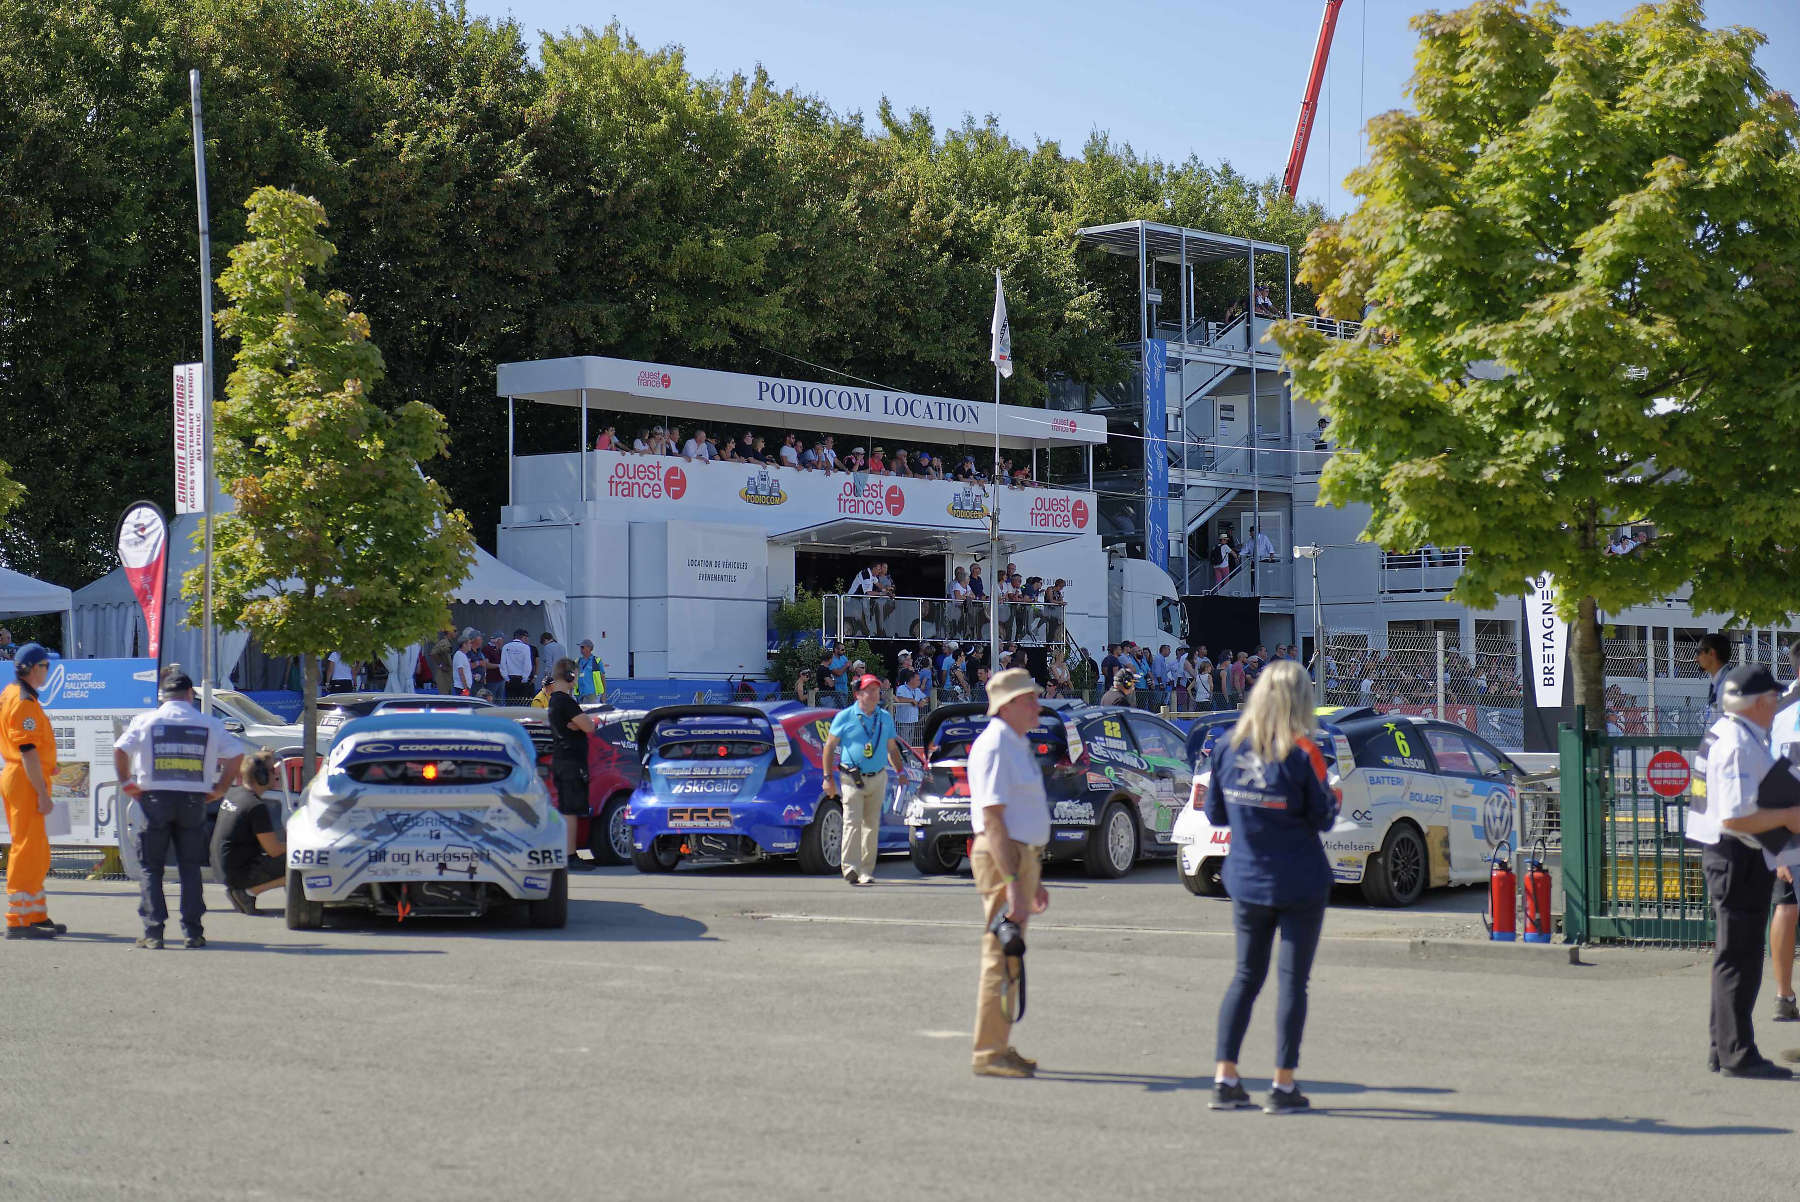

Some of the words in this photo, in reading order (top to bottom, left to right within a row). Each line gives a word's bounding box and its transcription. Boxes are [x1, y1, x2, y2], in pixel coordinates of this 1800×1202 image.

[637, 378, 661, 388] france
[639, 370, 661, 381] ouest
[758, 380, 870, 413] PODIOCOM
[883, 395, 979, 425] LOCATION
[176, 375, 185, 451] RALLYCROSS
[188, 412, 196, 476] STRICTEMENT
[196, 452, 202, 462] AU
[614, 460, 662, 481] ouest
[177, 455, 186, 504] CIRCUIT
[608, 475, 662, 500] france
[745, 494, 781, 505] PODIOCOM
[837, 494, 884, 516] france
[1035, 496, 1071, 512] ouest
[1030, 508, 1071, 528] france
[687, 559, 713, 568] LOCATION
[714, 560, 721, 568] DE
[1541, 590, 1555, 687] BRETAGNE
[66, 672, 93, 681] CIRCUIT
[64, 681, 106, 690] RALLYCROSS
[1104, 720, 1122, 738] 22
[1394, 731, 1411, 758] 6
[1392, 757, 1427, 770] NILSSON
[684, 780, 739, 793] SkiGeilo
[1409, 792, 1443, 805] BOLAGET
[290, 851, 330, 865] SBE
[528, 850, 565, 866] SBE
